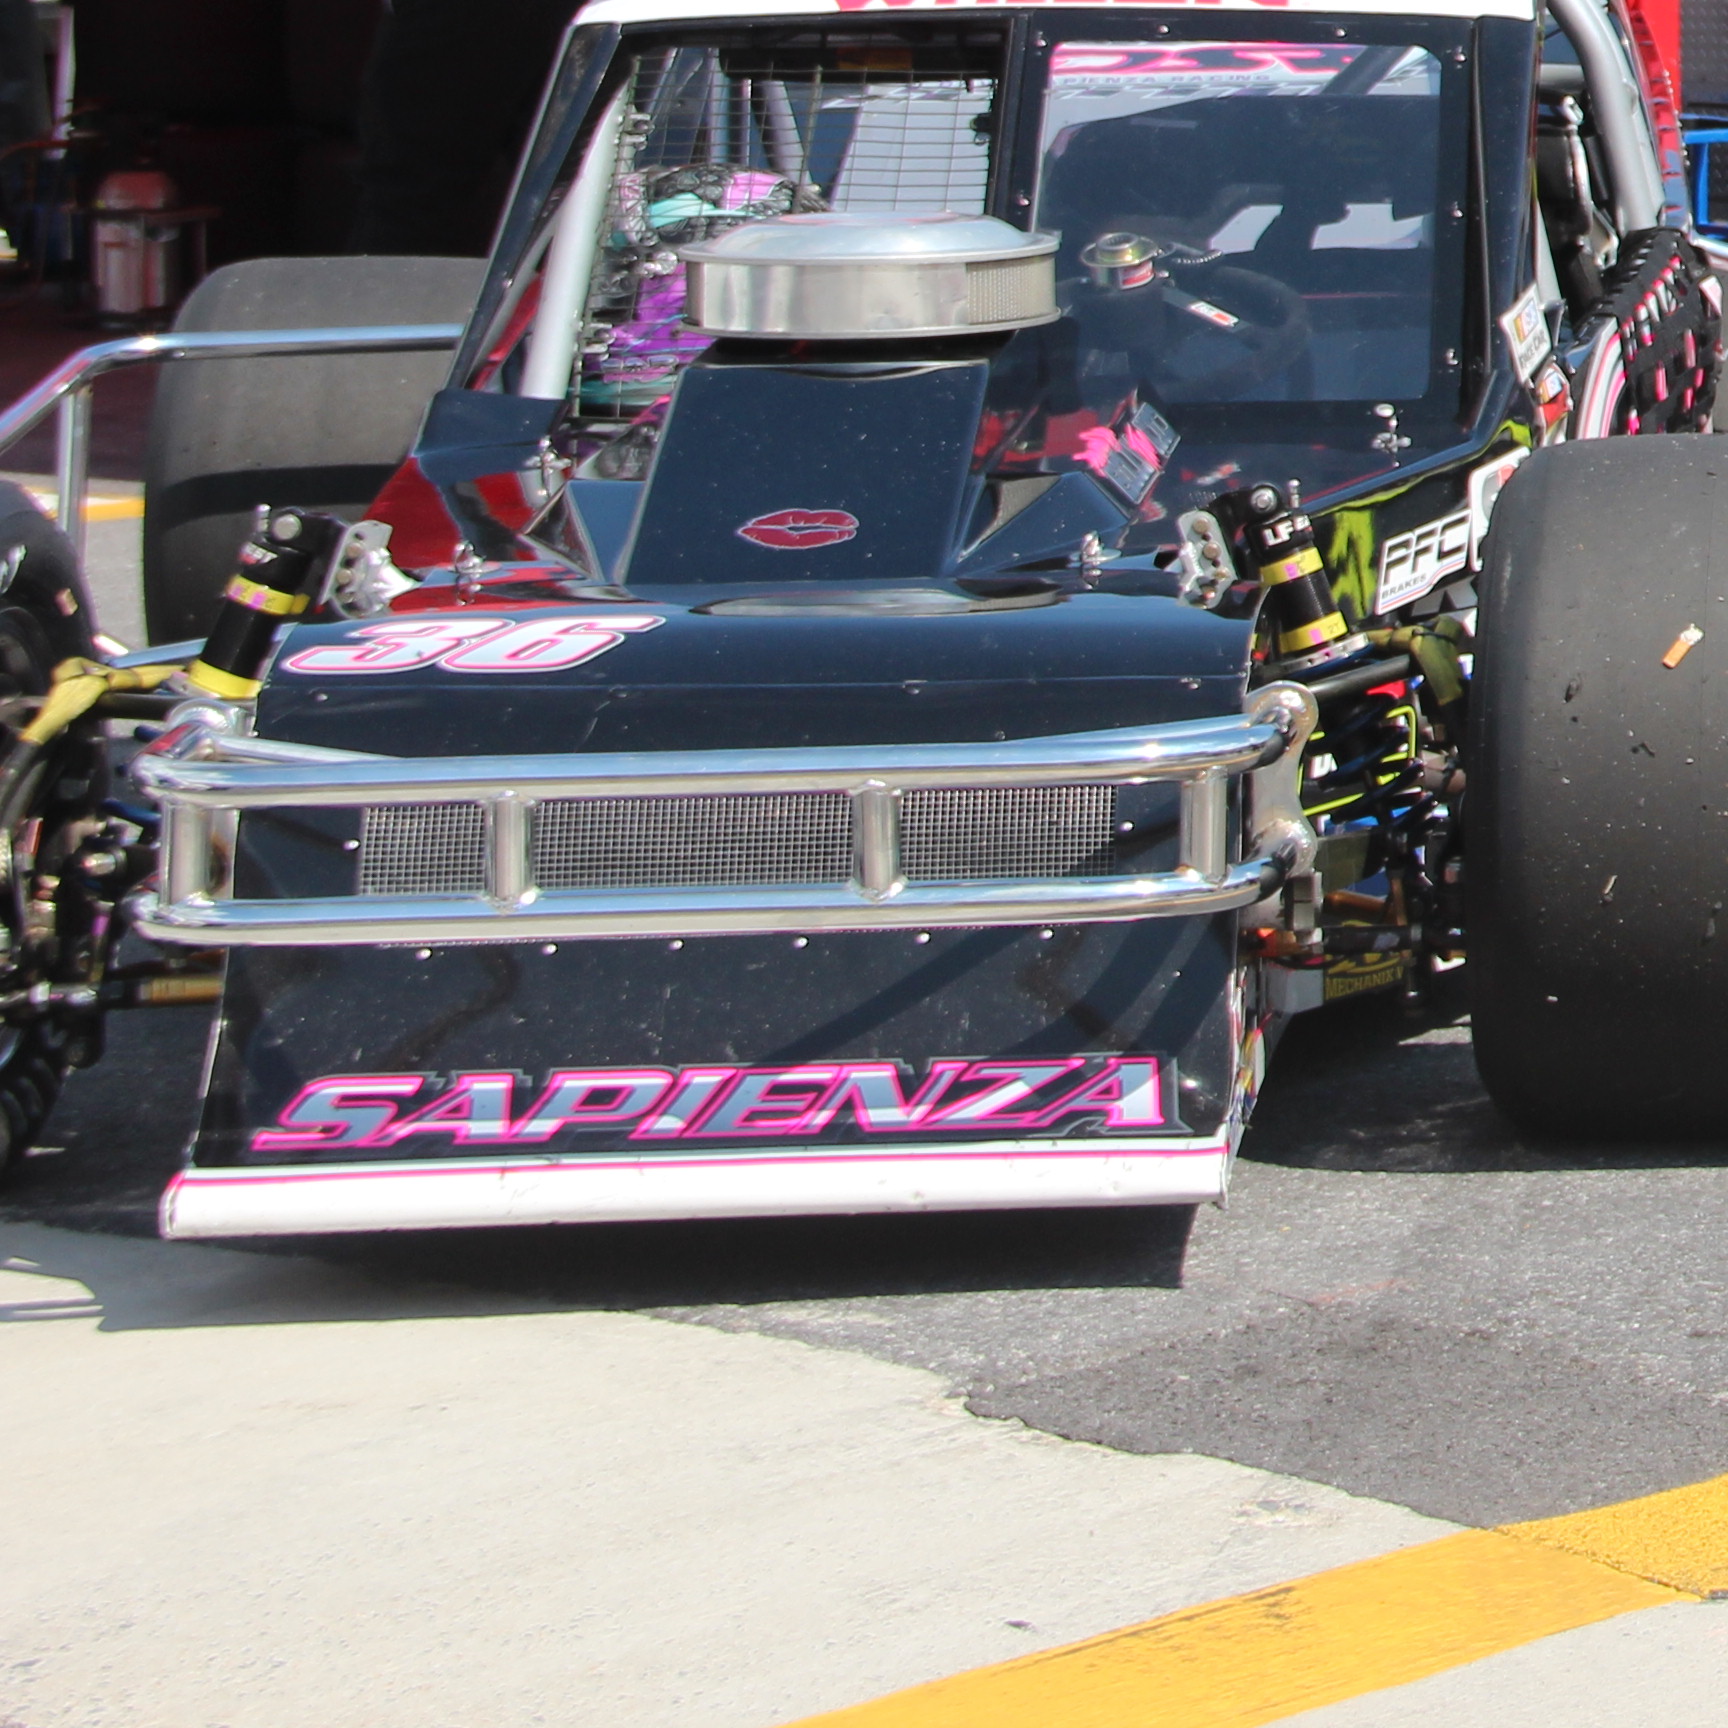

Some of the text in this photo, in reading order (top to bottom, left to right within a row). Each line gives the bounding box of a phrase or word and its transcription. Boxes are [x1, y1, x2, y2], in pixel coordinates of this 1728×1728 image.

[1262, 524, 1293, 547] LF
[1382, 515, 1470, 587] PFC
[1381, 573, 1427, 600] BRAKES
[282, 615, 667, 673] 36
[1325, 969, 1393, 1000] MECHANIX
[250, 1056, 1170, 1153] SAPIENZA
